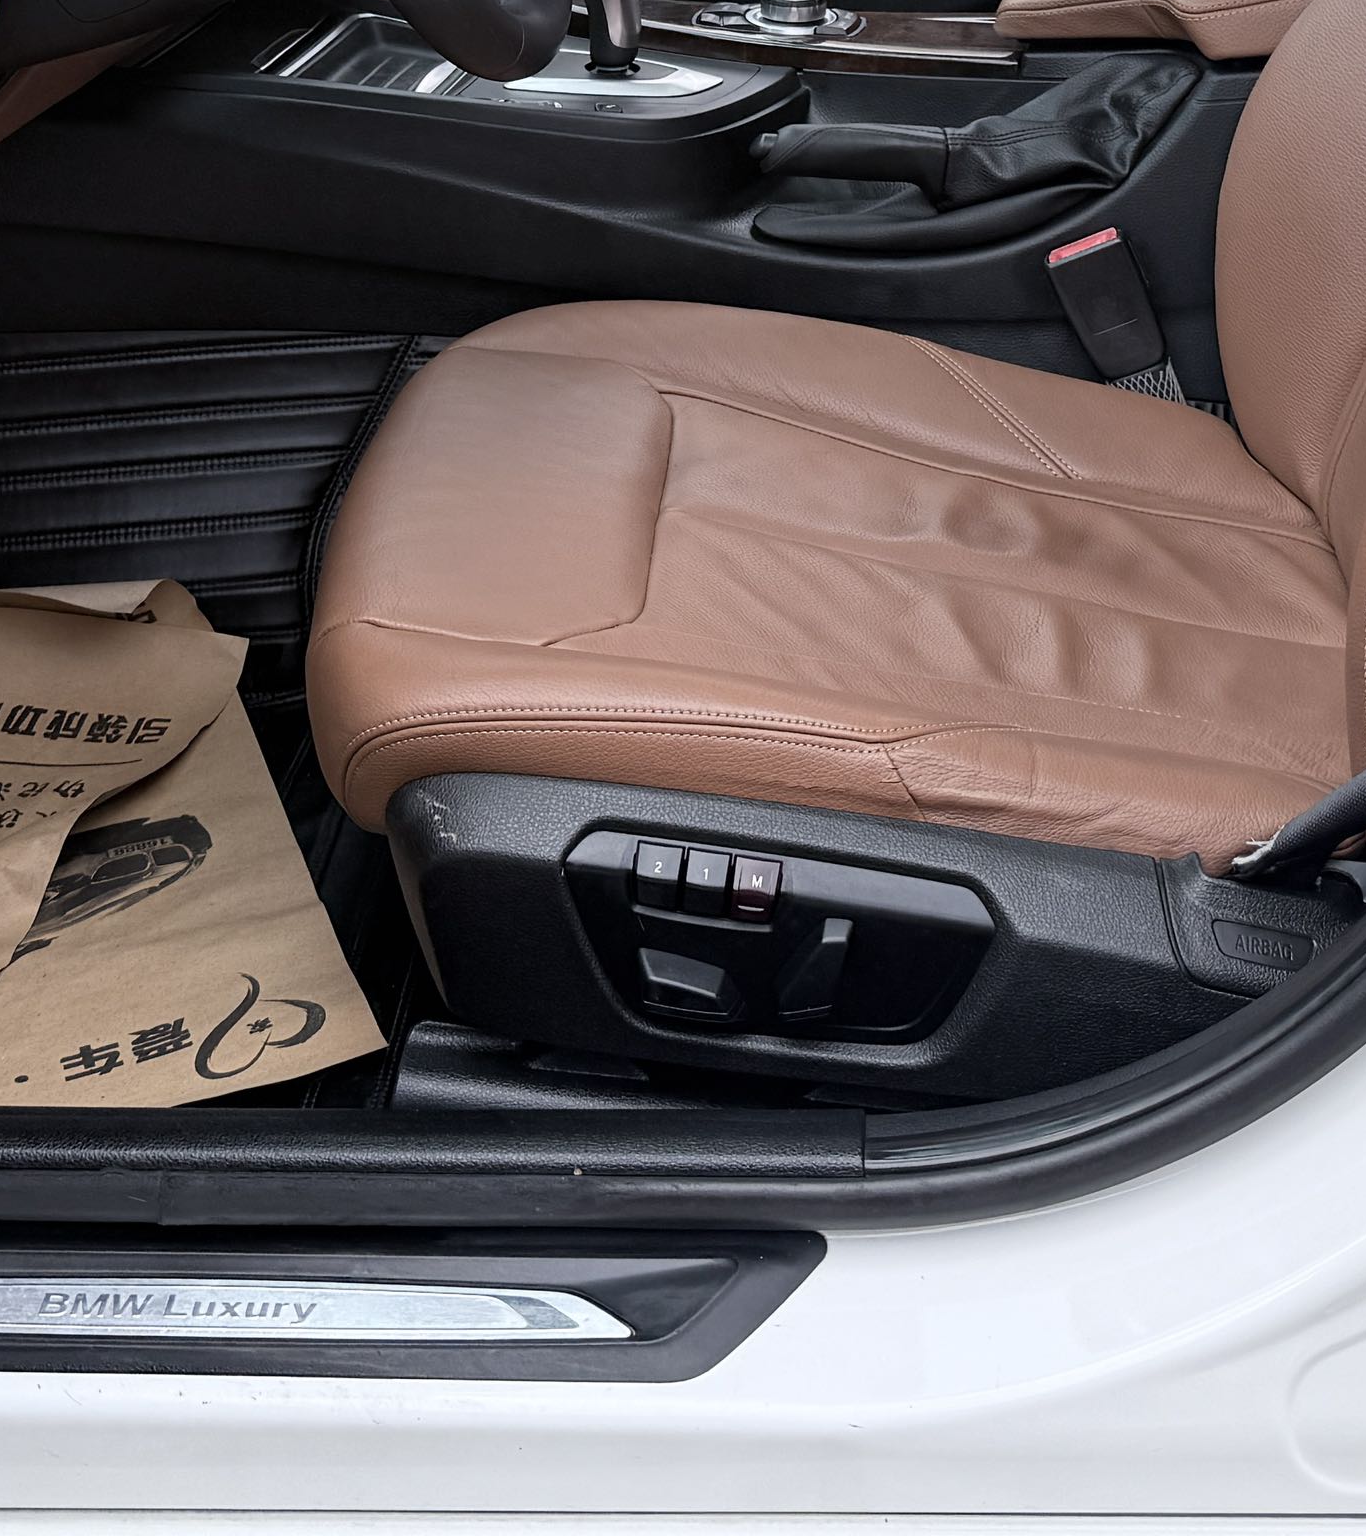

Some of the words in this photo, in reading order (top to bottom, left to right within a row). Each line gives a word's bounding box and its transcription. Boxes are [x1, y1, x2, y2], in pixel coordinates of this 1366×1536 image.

[654, 861, 663, 874] 2
[702, 868, 709, 881] 1
[751, 875, 763, 889] M
[1235, 934, 1294, 961] AIRBAG
[38, 1292, 154, 1316] BMW
[163, 1293, 317, 1324] Luxury
